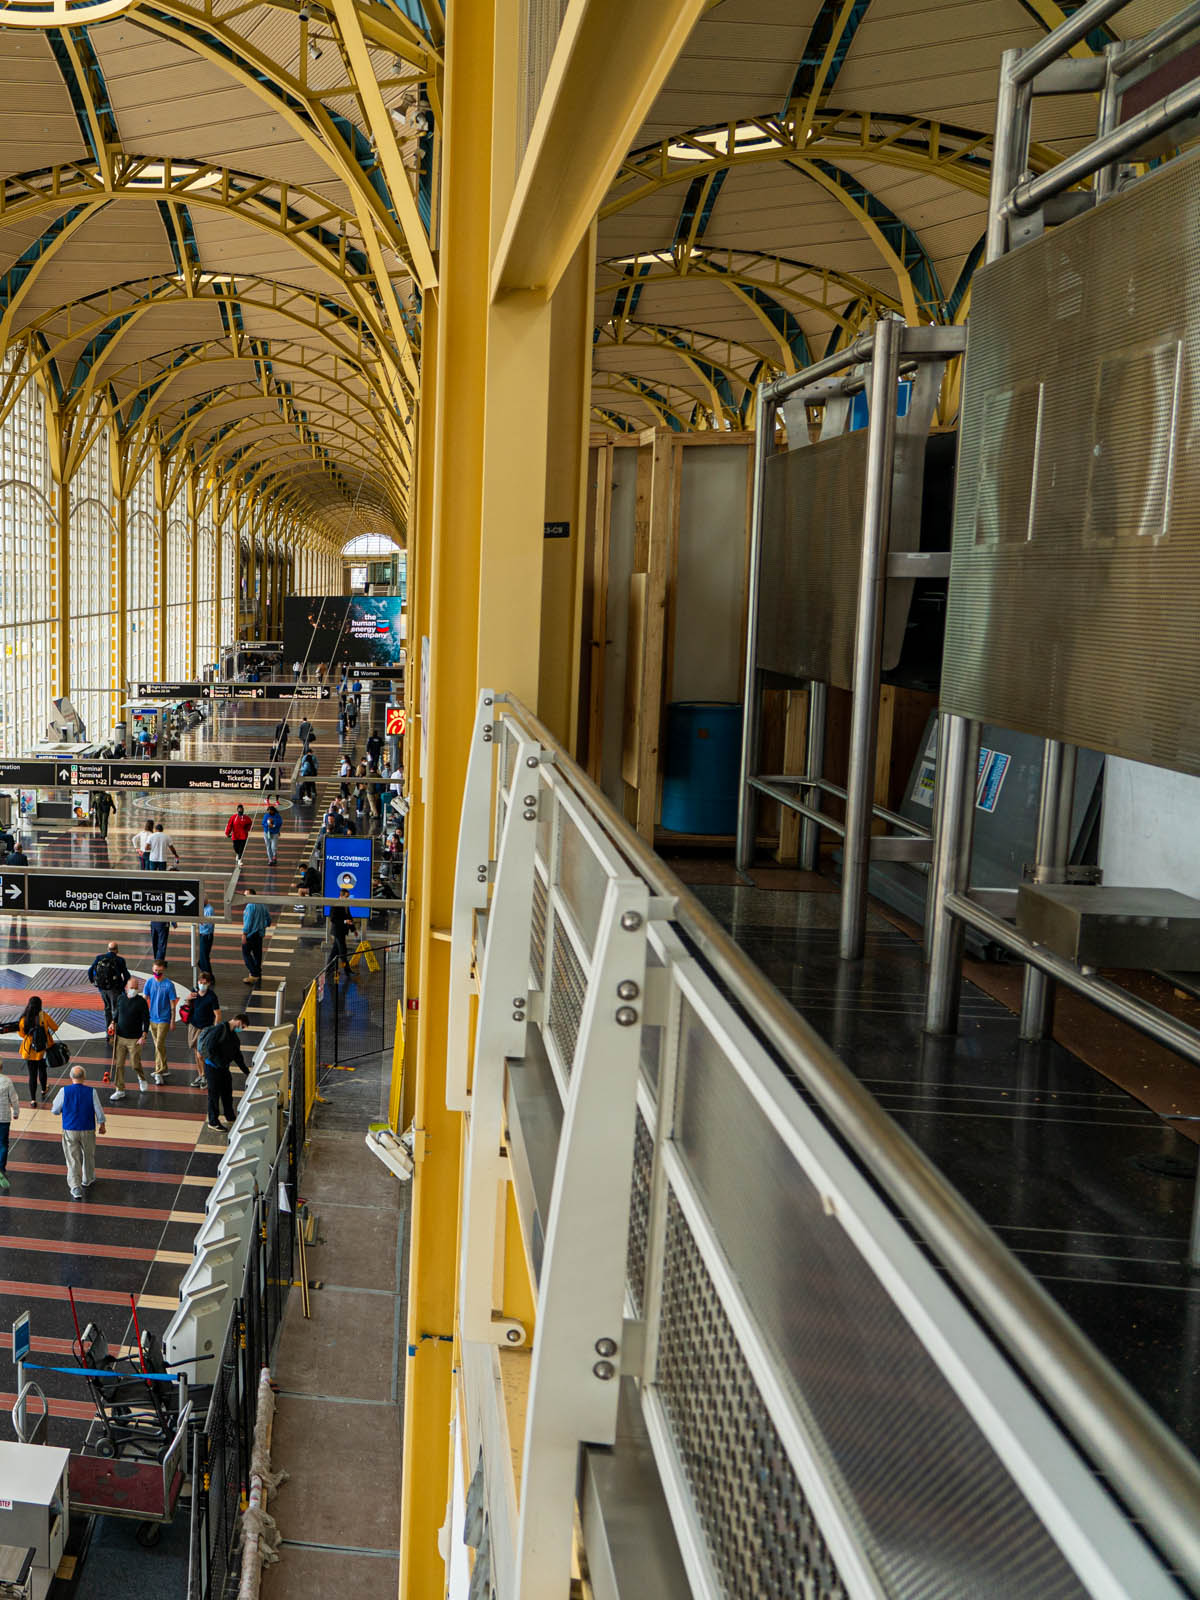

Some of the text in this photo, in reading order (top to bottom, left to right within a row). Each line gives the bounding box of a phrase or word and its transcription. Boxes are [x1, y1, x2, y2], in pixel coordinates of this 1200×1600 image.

[66, 890, 162, 901] Baggage Claim Taxi
[48, 900, 162, 912] Ride App Private Pickup
